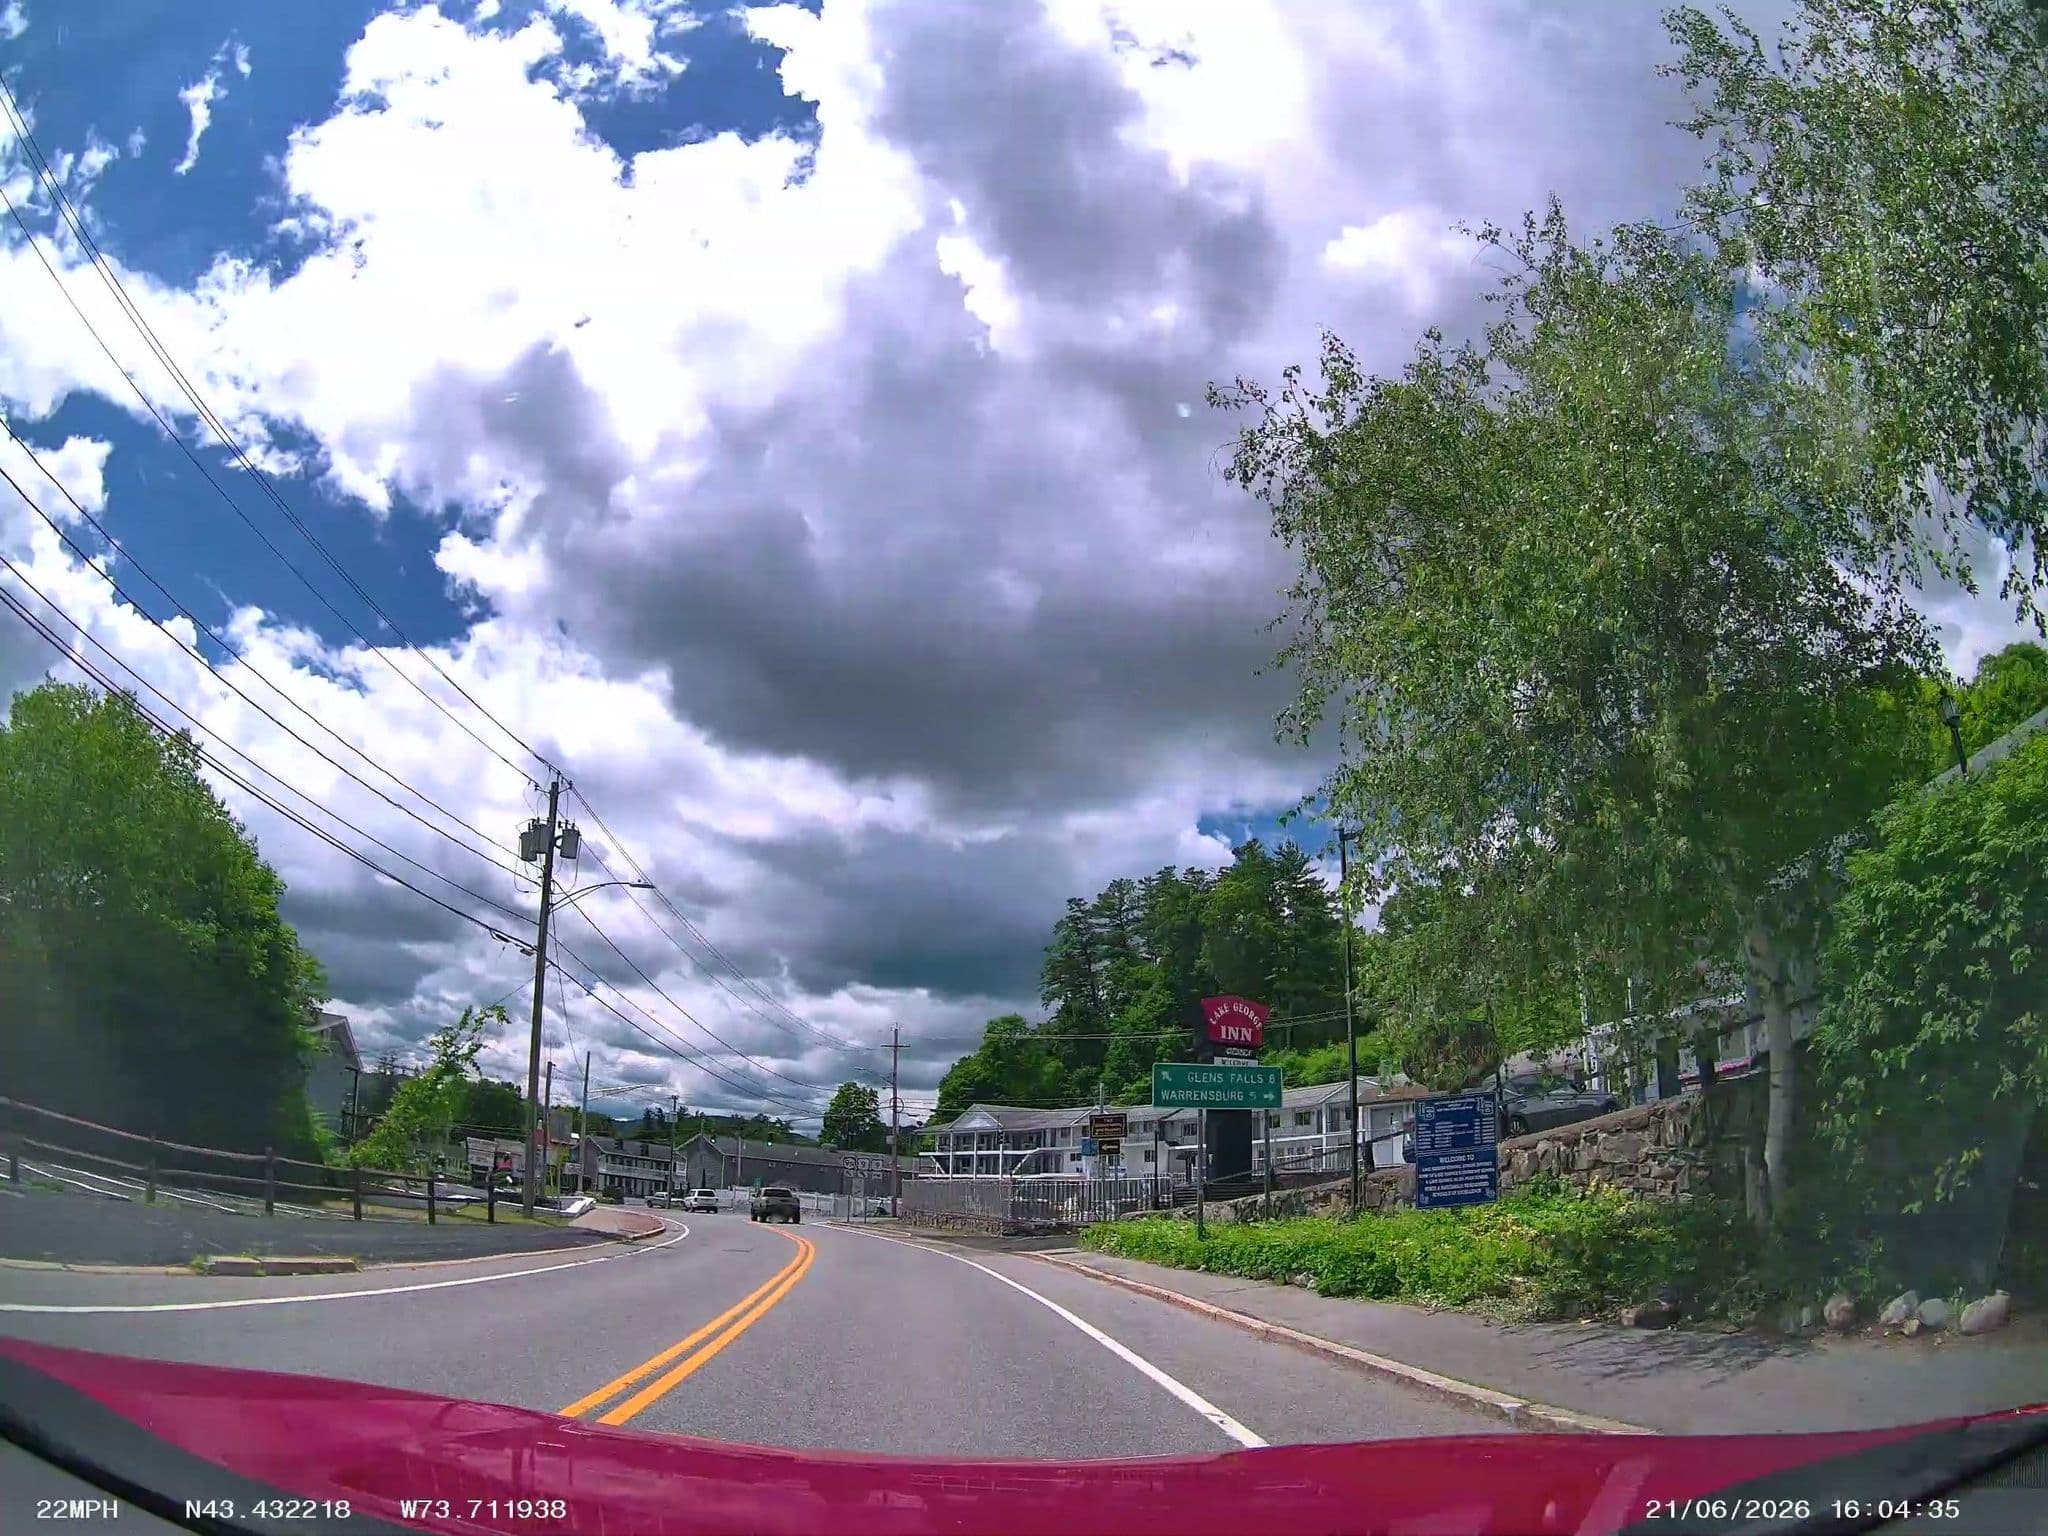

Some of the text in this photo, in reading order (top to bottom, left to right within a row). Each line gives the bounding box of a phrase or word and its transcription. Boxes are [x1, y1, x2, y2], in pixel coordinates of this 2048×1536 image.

[1209, 1002, 1262, 1030] LAKE GEORGE
[1220, 1025, 1252, 1042] INN
[1187, 1072, 1224, 1084] GLENS
[1230, 1073, 1264, 1084] FALLS
[1160, 1090, 1244, 1102] WARRENSBURG
